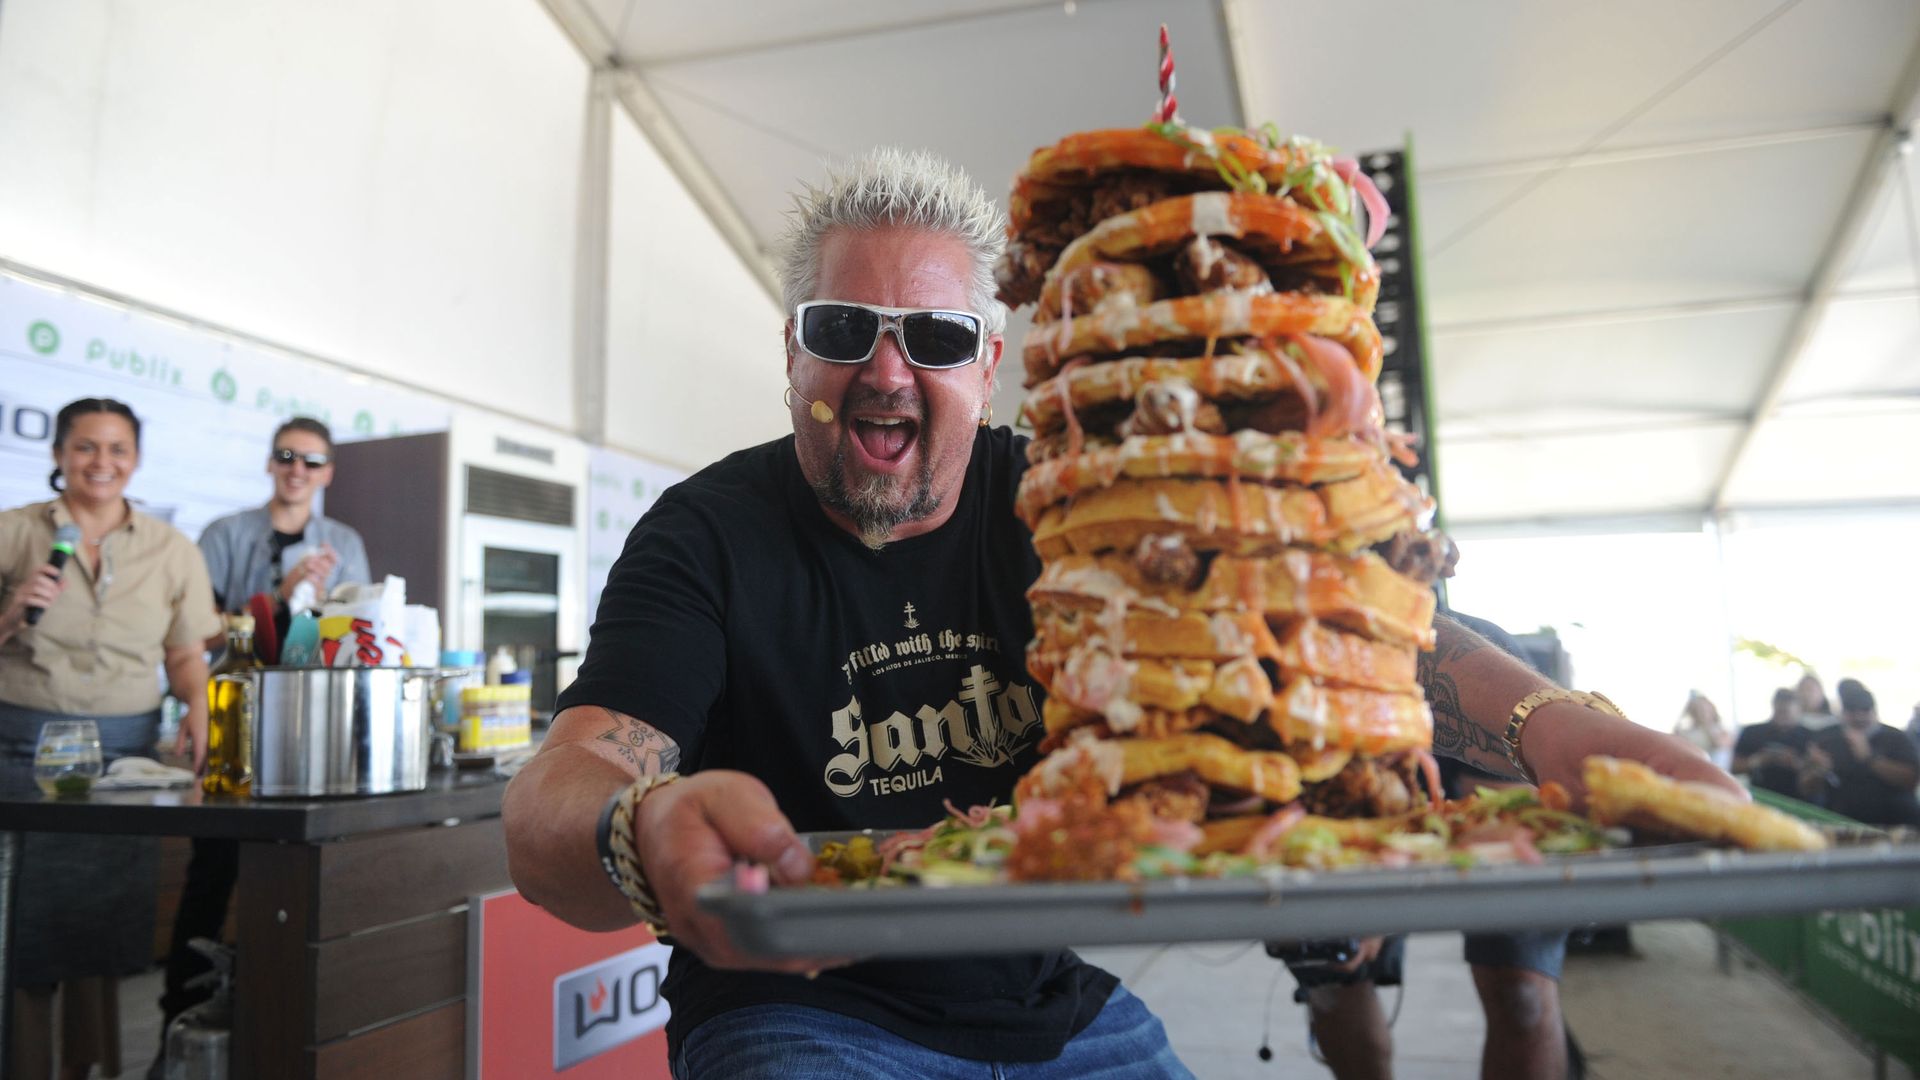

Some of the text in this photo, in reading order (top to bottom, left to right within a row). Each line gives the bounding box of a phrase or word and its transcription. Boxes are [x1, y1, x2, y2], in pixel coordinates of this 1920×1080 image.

[895, 632, 932, 656] with
[938, 629, 963, 652] the
[872, 667, 885, 676] LOS
[886, 662, 902, 672] ALTOS
[825, 664, 1042, 798] Santo
[869, 766, 943, 796] TEQUILA
[575, 965, 659, 1039] WO
